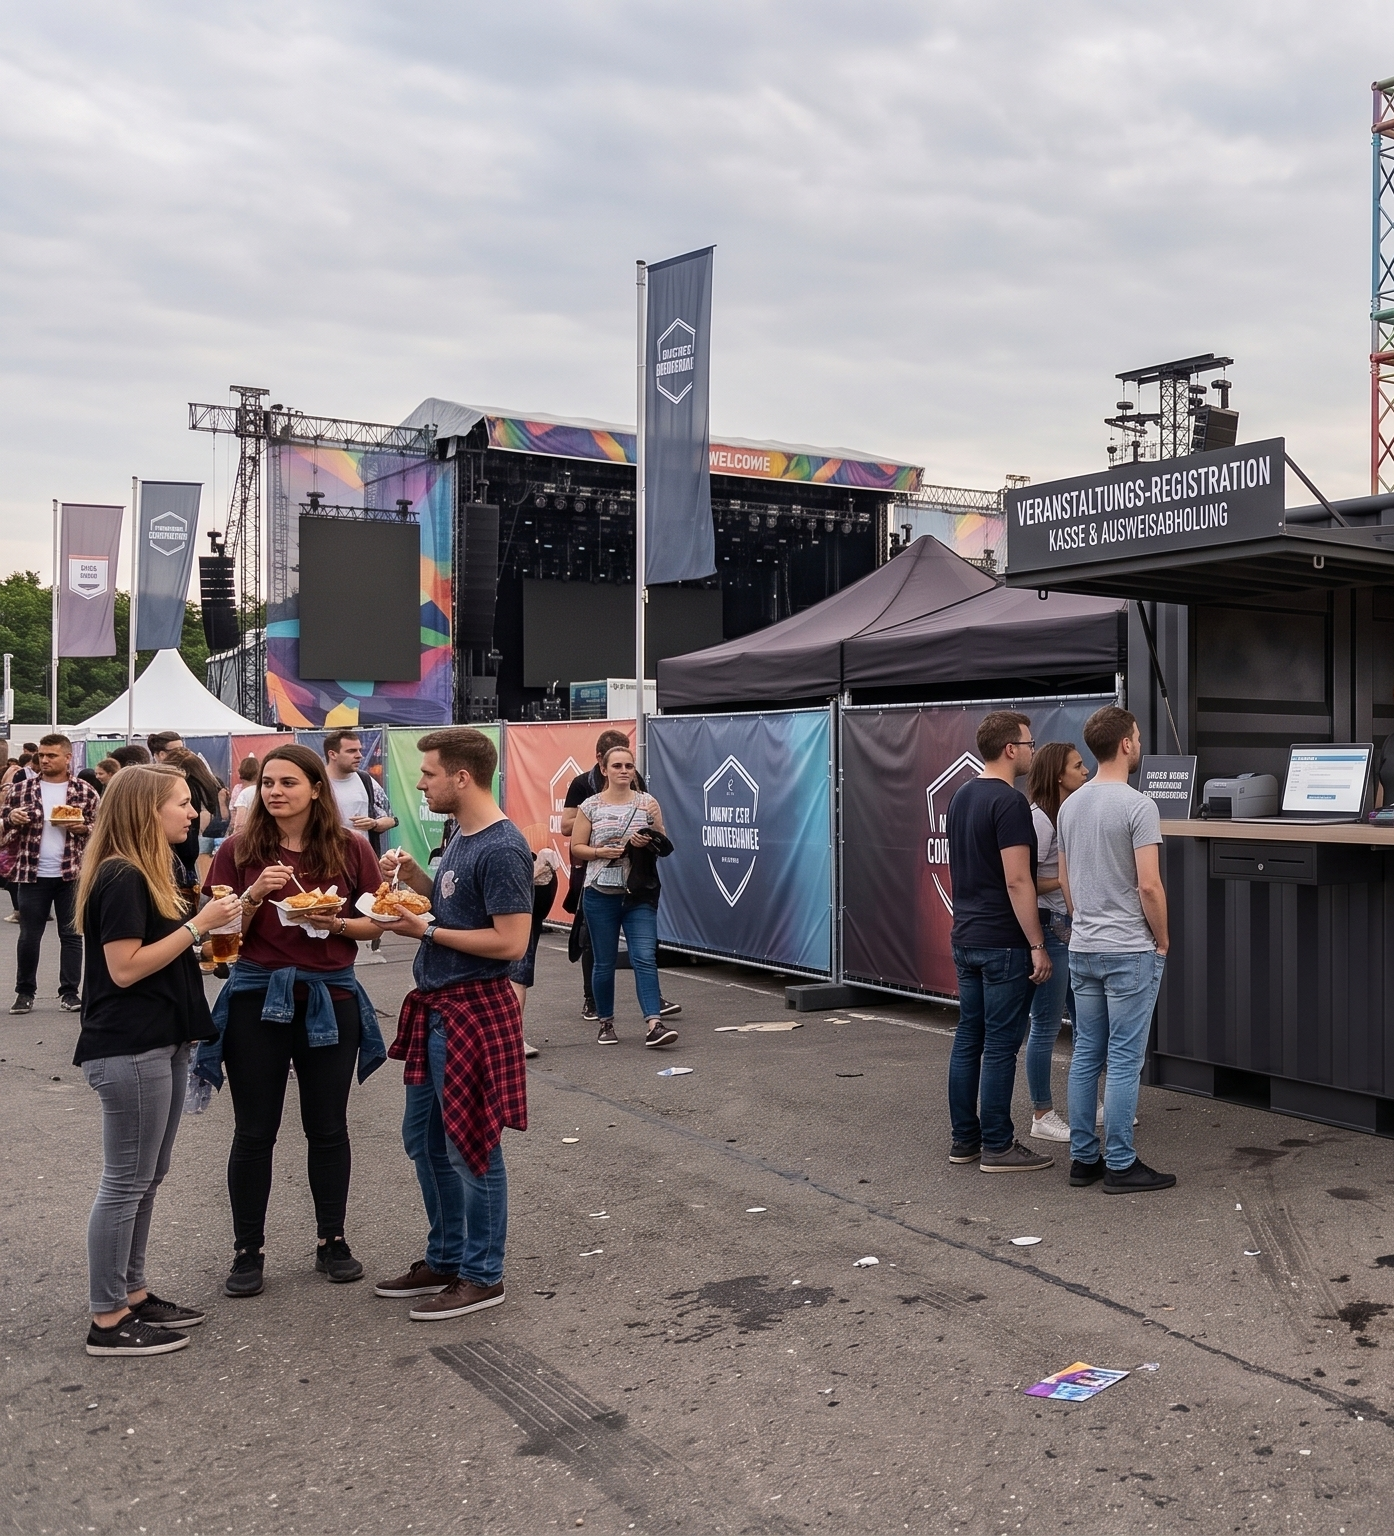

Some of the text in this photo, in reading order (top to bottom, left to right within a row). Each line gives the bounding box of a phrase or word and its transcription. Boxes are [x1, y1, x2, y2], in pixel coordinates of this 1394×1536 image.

[1017, 455, 1271, 527] VERANSTALTUNGS-REGISTRATION
[1049, 502, 1228, 552] KASSE & AUSWEISABHOLUNG
